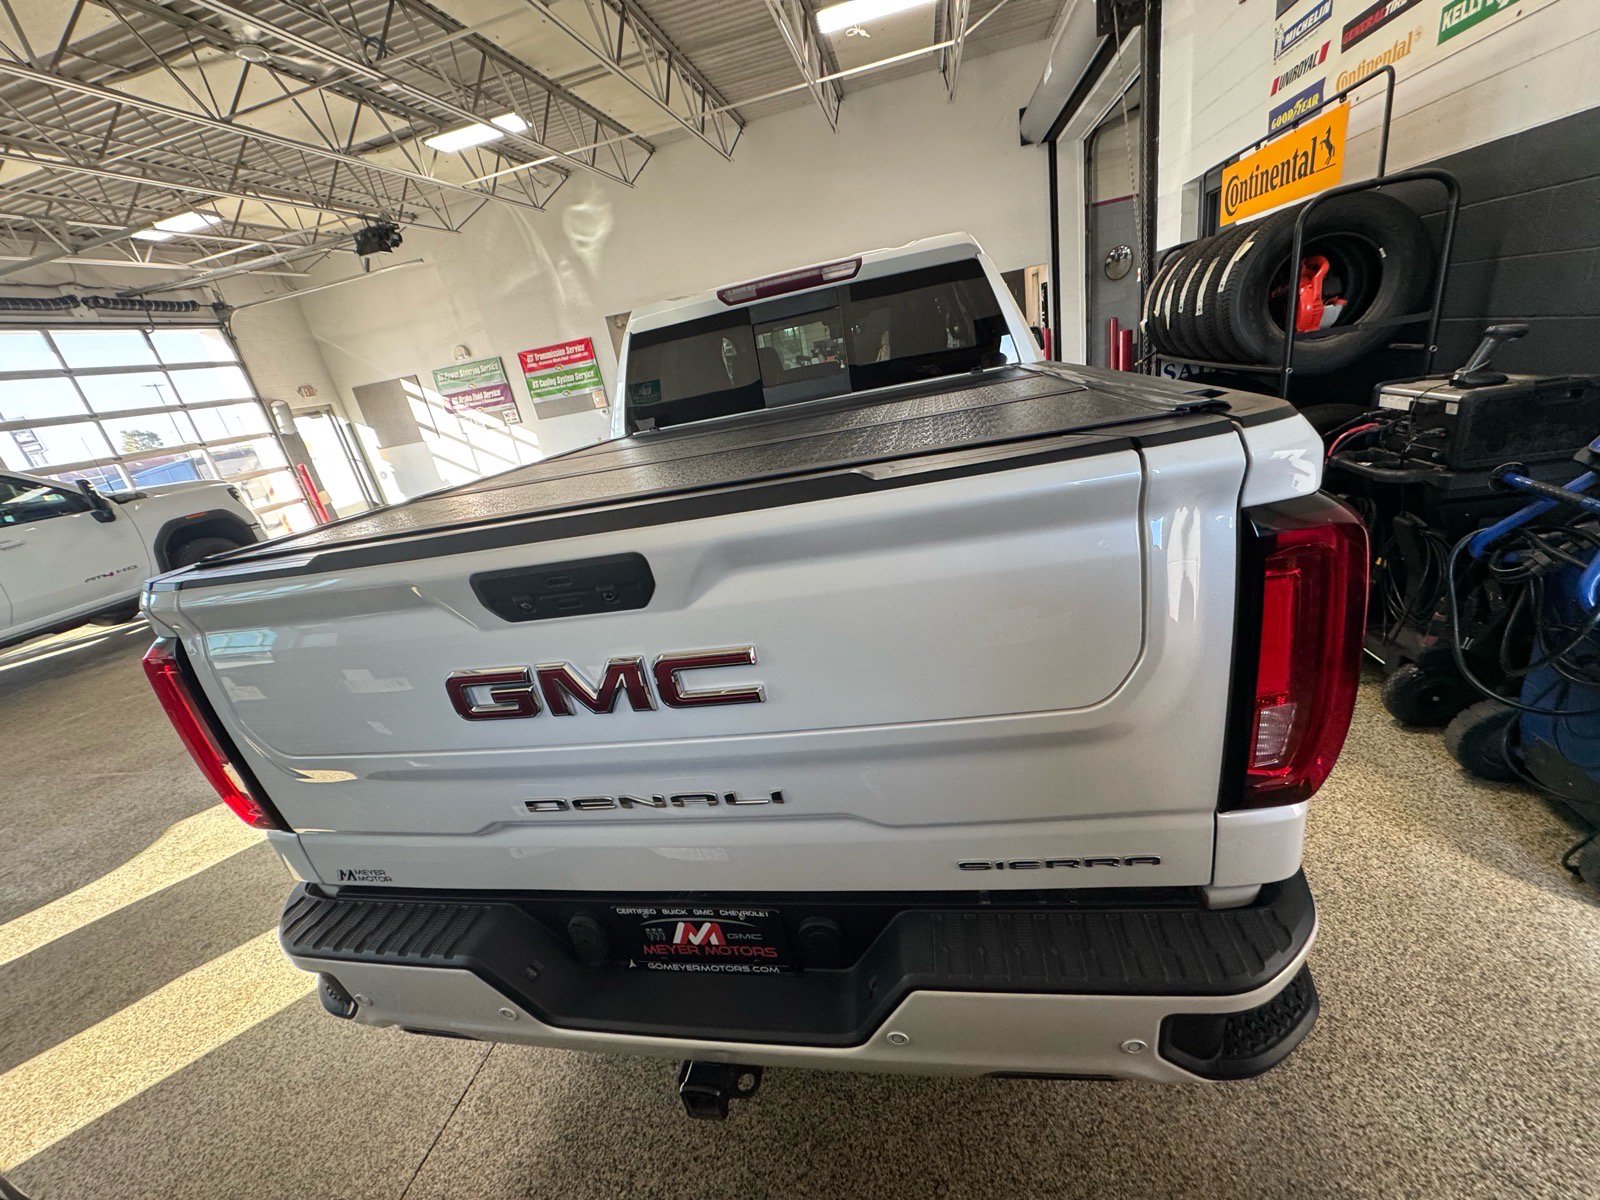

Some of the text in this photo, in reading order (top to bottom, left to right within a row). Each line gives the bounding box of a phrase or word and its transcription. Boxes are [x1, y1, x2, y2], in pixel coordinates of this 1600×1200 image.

[1283, 1, 1331, 46] MICHELIN
[1342, 7, 1387, 45] GENERAL
[1278, 50, 1319, 91] UNIROYAL
[1336, 31, 1412, 93] Continental
[1271, 93, 1319, 130] GOODYEAR
[1224, 136, 1317, 217] Continental
[566, 344, 585, 355] Service
[480, 362, 499, 373] Service
[557, 374, 575, 385] System
[575, 371, 594, 381] Service
[483, 389, 501, 399] Service
[445, 643, 766, 721] GMC
[524, 787, 785, 812] DENALI
[957, 852, 1162, 870] SIERRA
[616, 907, 657, 916] CERTIFIED
[661, 908, 688, 916] BUICK
[719, 908, 769, 918] CHEVROLET
[727, 932, 763, 941] GMC
[642, 943, 778, 958] MEYER MOTORS
[647, 962, 780, 974] GOMEYERMOTORS.COM
